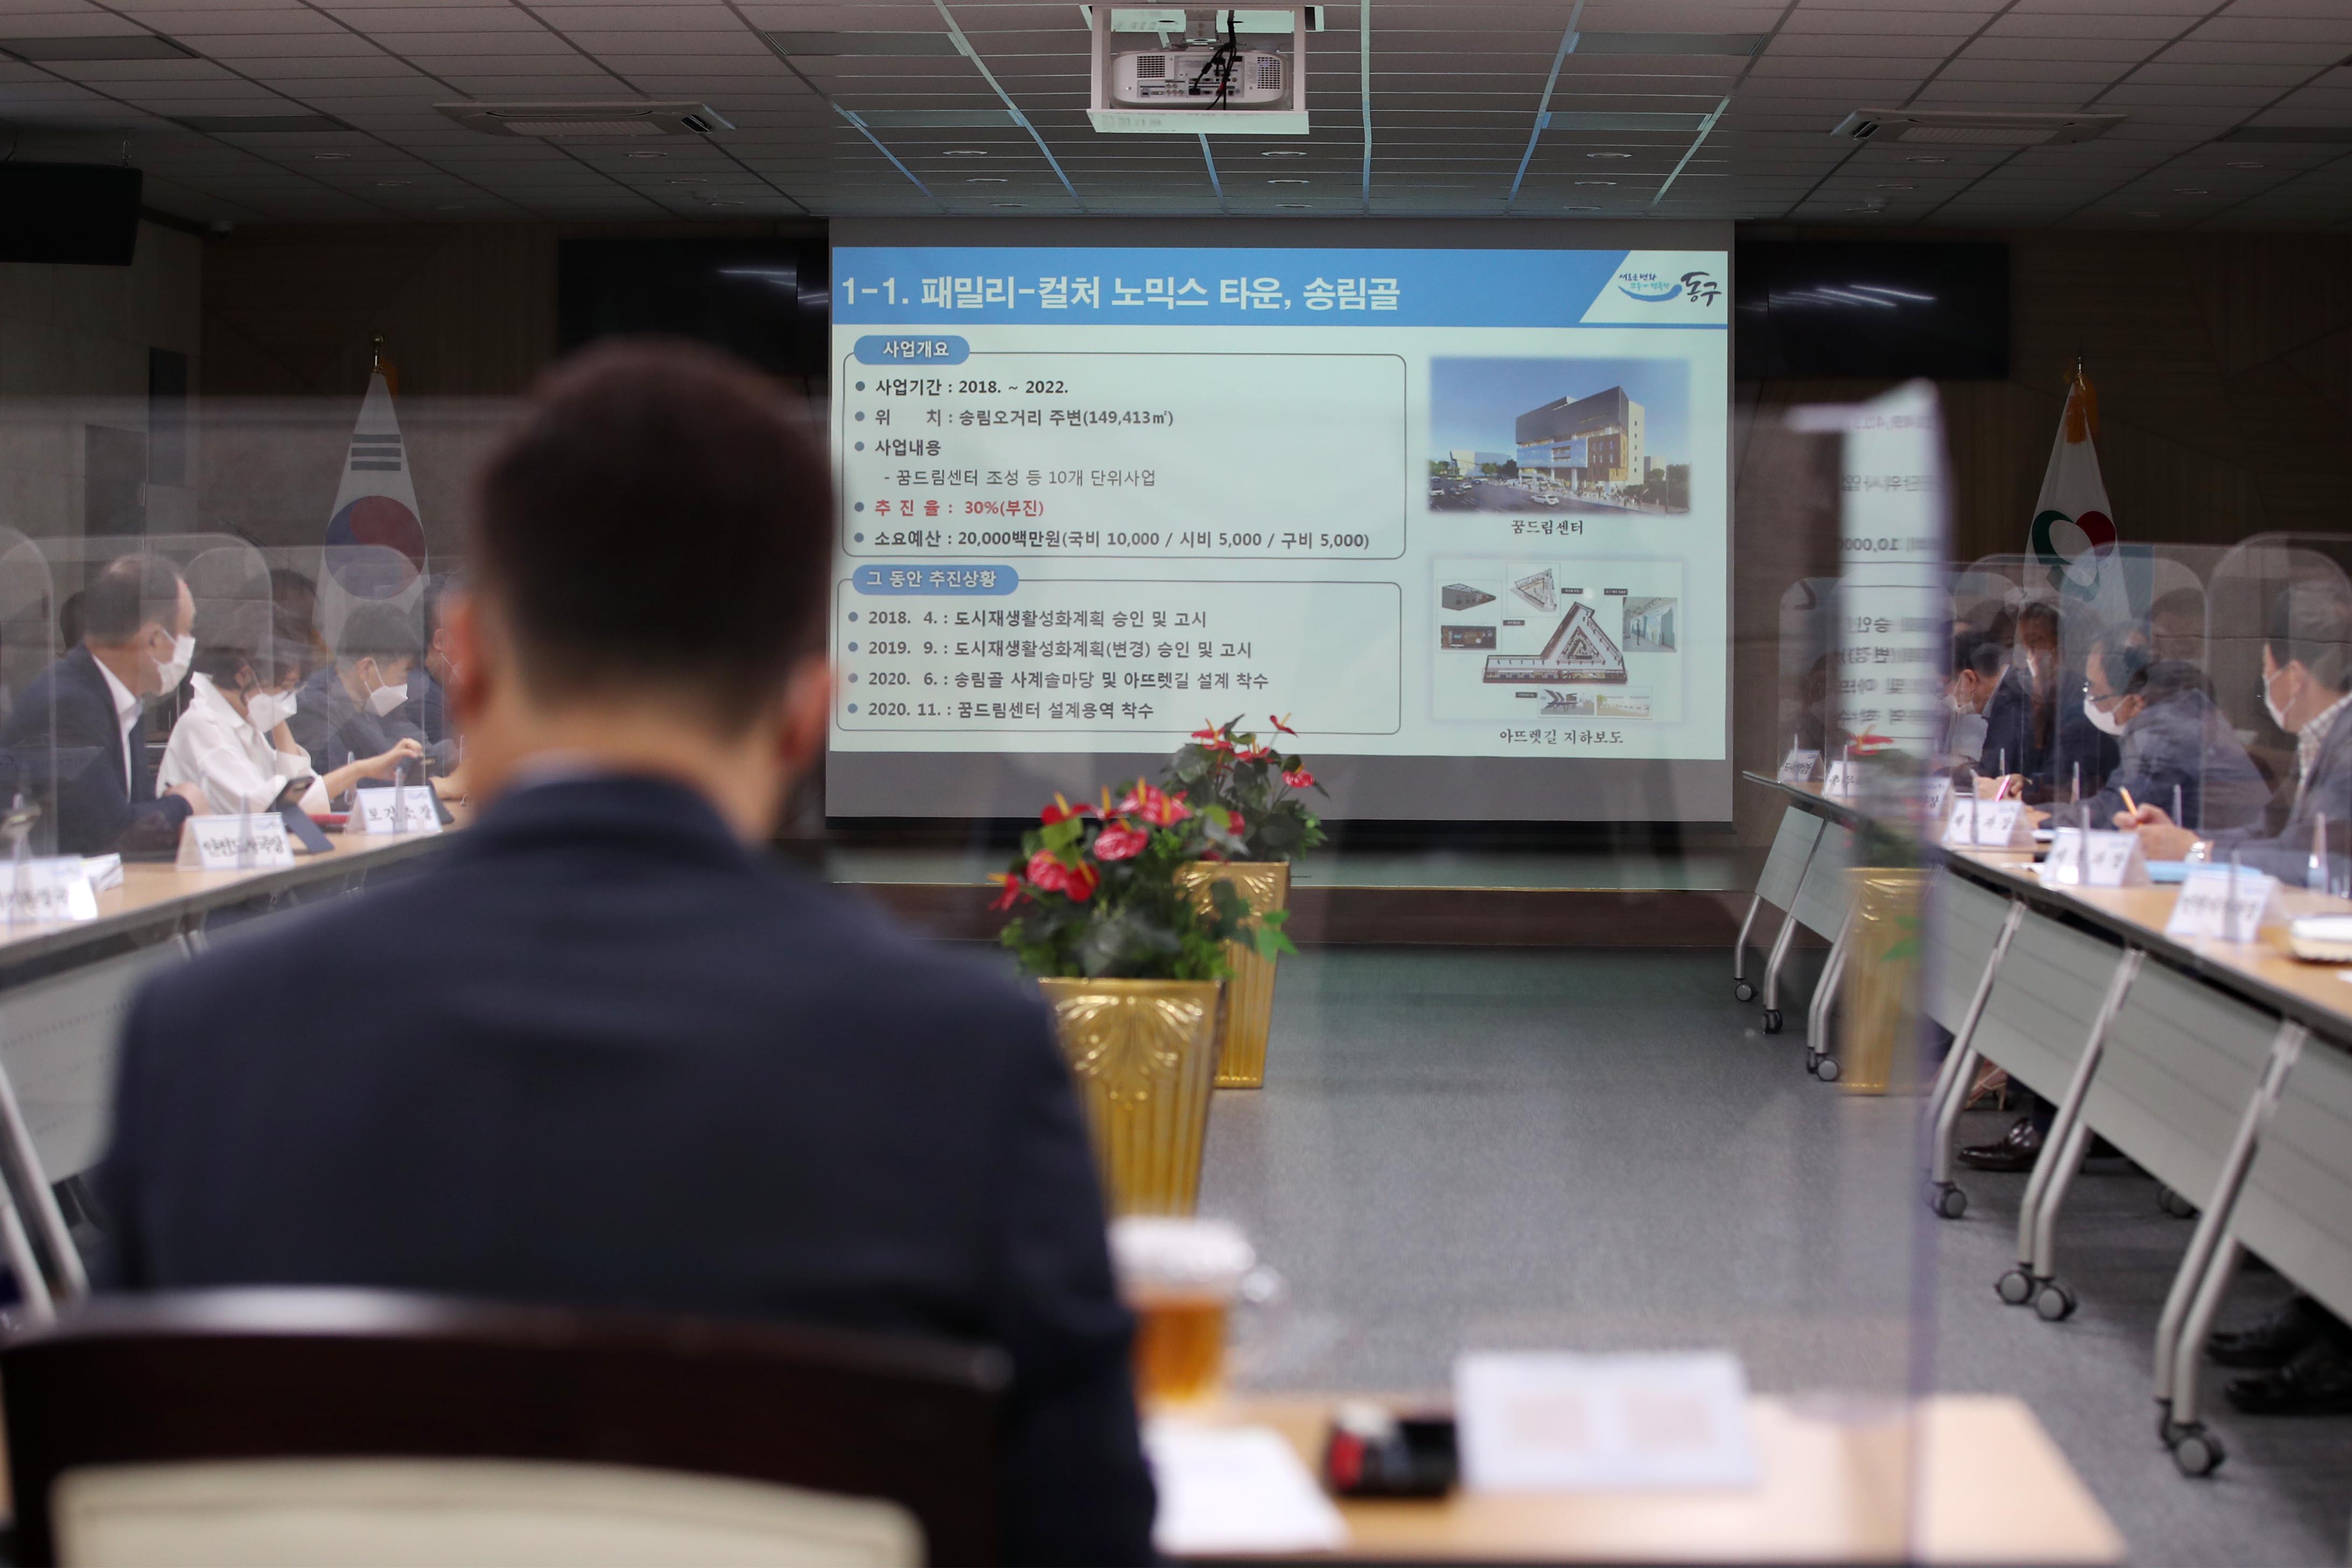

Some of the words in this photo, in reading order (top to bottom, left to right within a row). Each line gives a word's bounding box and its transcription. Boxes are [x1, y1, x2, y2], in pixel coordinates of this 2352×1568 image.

[842, 277, 909, 305] 1-1.
[921, 276, 1100, 309] 패밀리-컬처
[1111, 276, 1209, 310] 노믹스
[1220, 277, 1291, 310] 타운,
[1303, 277, 1401, 311] 송림골
[1679, 271, 1722, 307] 동구
[883, 340, 949, 359] 사업개요
[876, 379, 942, 396] 사업기간
[958, 380, 1001, 394] 2018.
[1025, 380, 1068, 394] 2022.
[958, 409, 1041, 426] 송림오거리
[875, 439, 942, 457] 사업내용
[896, 469, 978, 486] 꿈드림센터
[986, 469, 1018, 486] 조성
[1026, 470, 1042, 486] 등
[1049, 470, 1083, 487] 10개
[1091, 470, 1155, 487] 단위사업
[964, 500, 1044, 517] 30%(부진)
[1511, 520, 1583, 535] 꿈드림센터
[874, 530, 942, 548] 소요예산
[958, 530, 1099, 548] 20,000백만원(국비
[1107, 532, 1160, 548] 10,000
[1180, 531, 1211, 549] 시비
[1219, 533, 1262, 548] 5,000
[1281, 532, 1312, 550] 구비
[1320, 534, 1369, 550] 5,000)
[866, 571, 883, 585] 그
[890, 569, 922, 587] 동안
[929, 570, 997, 588] 추진상황
[868, 611, 911, 624] 2018.
[923, 611, 937, 624] 4.
[954, 610, 1104, 627] 도시재생활성화계획
[1112, 610, 1144, 628] 승인
[1152, 611, 1167, 628] 및
[1174, 611, 1206, 628] 고시
[869, 641, 911, 654] 2019.
[923, 641, 937, 654] 9.
[954, 640, 1150, 658] 도시재생활성화계획(변경)
[1157, 641, 1189, 659] 승인
[1198, 641, 1213, 658] 및
[1220, 641, 1251, 659] 고시
[869, 672, 911, 685] 2020.
[923, 672, 937, 685] 6.
[954, 671, 1004, 689] 송림골
[1011, 670, 1095, 689] 사계솔마당
[1102, 671, 1117, 689] 및
[1124, 671, 1188, 689] 아뜨렛길
[1196, 672, 1229, 690] 설계
[1236, 672, 1269, 690] 착수
[868, 702, 911, 716] 2020.
[918, 703, 941, 716] 11.
[957, 702, 1040, 719] 꿈드림센터
[1048, 702, 1114, 719] 설계용역
[1121, 702, 1154, 720] 착수
[1500, 728, 1557, 745] 아뜨렛길
[1564, 729, 1623, 745] 지하보도
